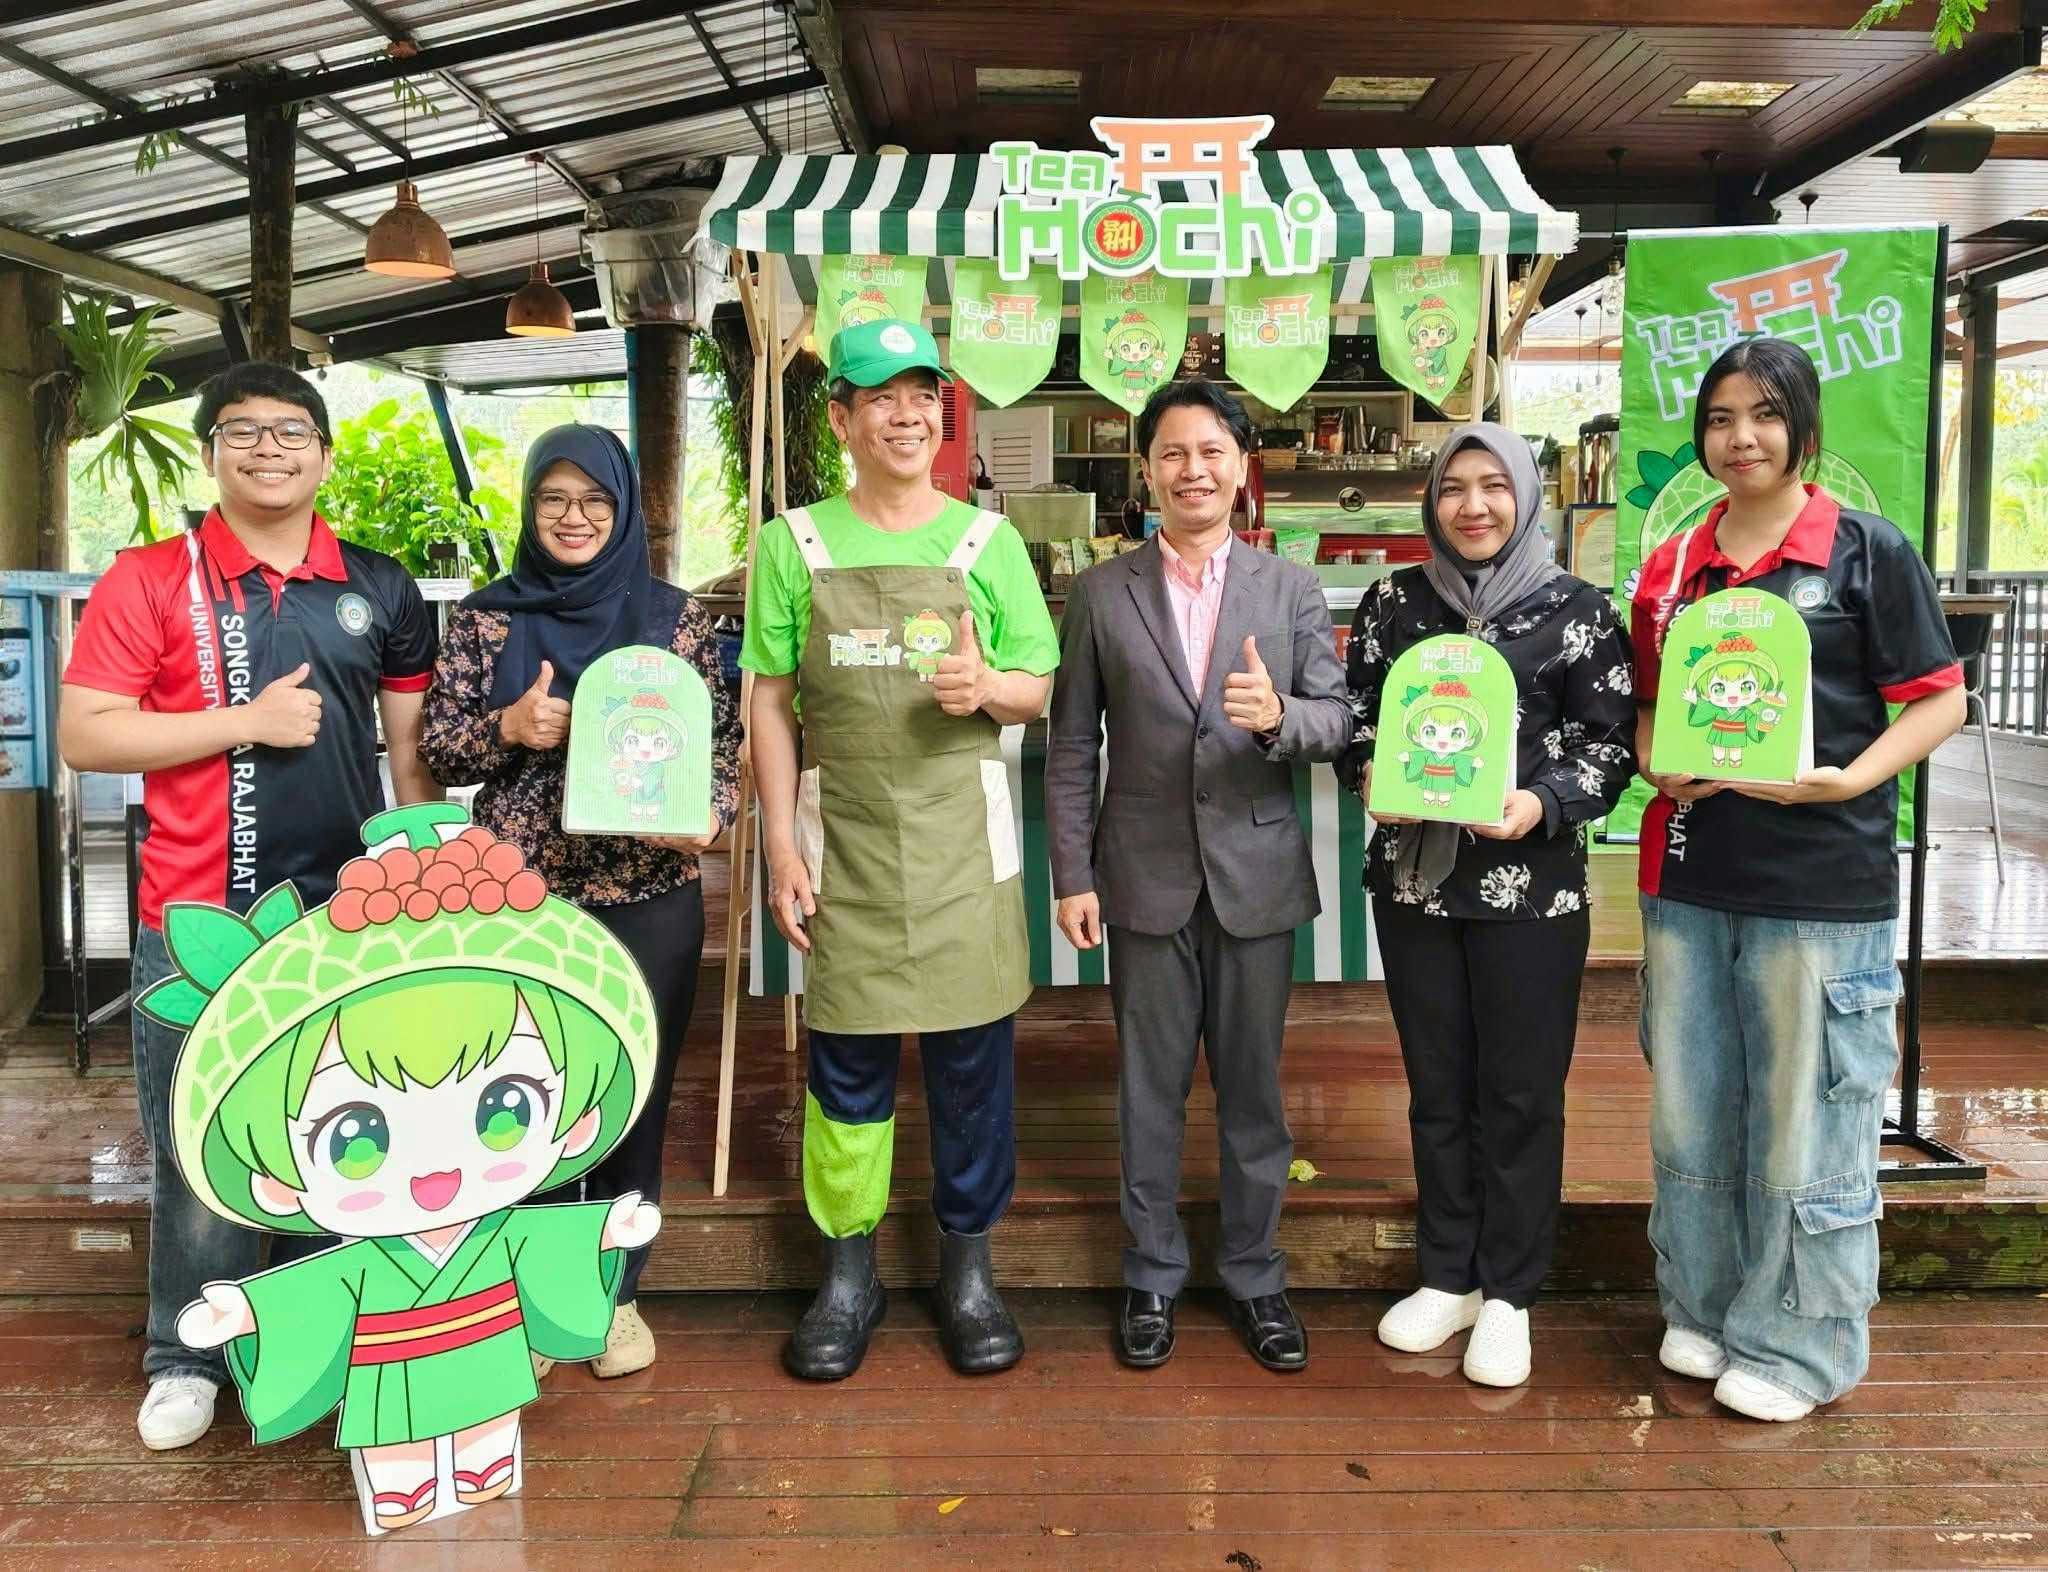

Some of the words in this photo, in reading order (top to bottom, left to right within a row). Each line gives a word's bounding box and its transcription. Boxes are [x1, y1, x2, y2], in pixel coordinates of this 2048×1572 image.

[991, 144, 1109, 193] Tea
[1635, 309, 1729, 360] Tea
[232, 761, 257, 894] RAJABHAT
